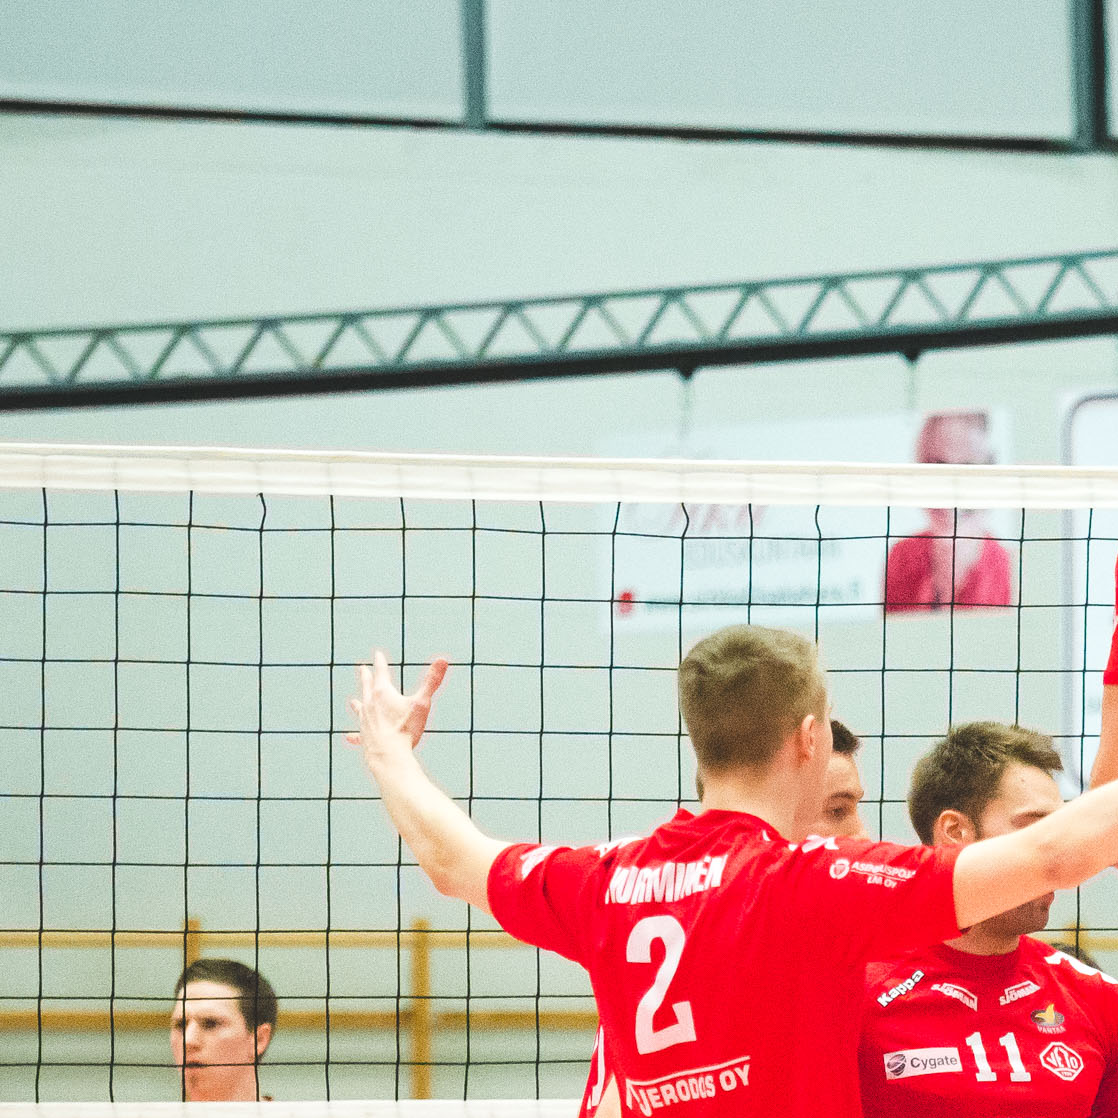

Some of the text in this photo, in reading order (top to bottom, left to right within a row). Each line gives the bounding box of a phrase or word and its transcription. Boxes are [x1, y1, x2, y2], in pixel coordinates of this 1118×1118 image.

[625, 914, 698, 1055] 2
[877, 969, 925, 1008] Kappa
[910, 1055, 958, 1071] Cygate
[964, 1031, 1032, 1082] 11
[719, 1063, 751, 1092] OY
